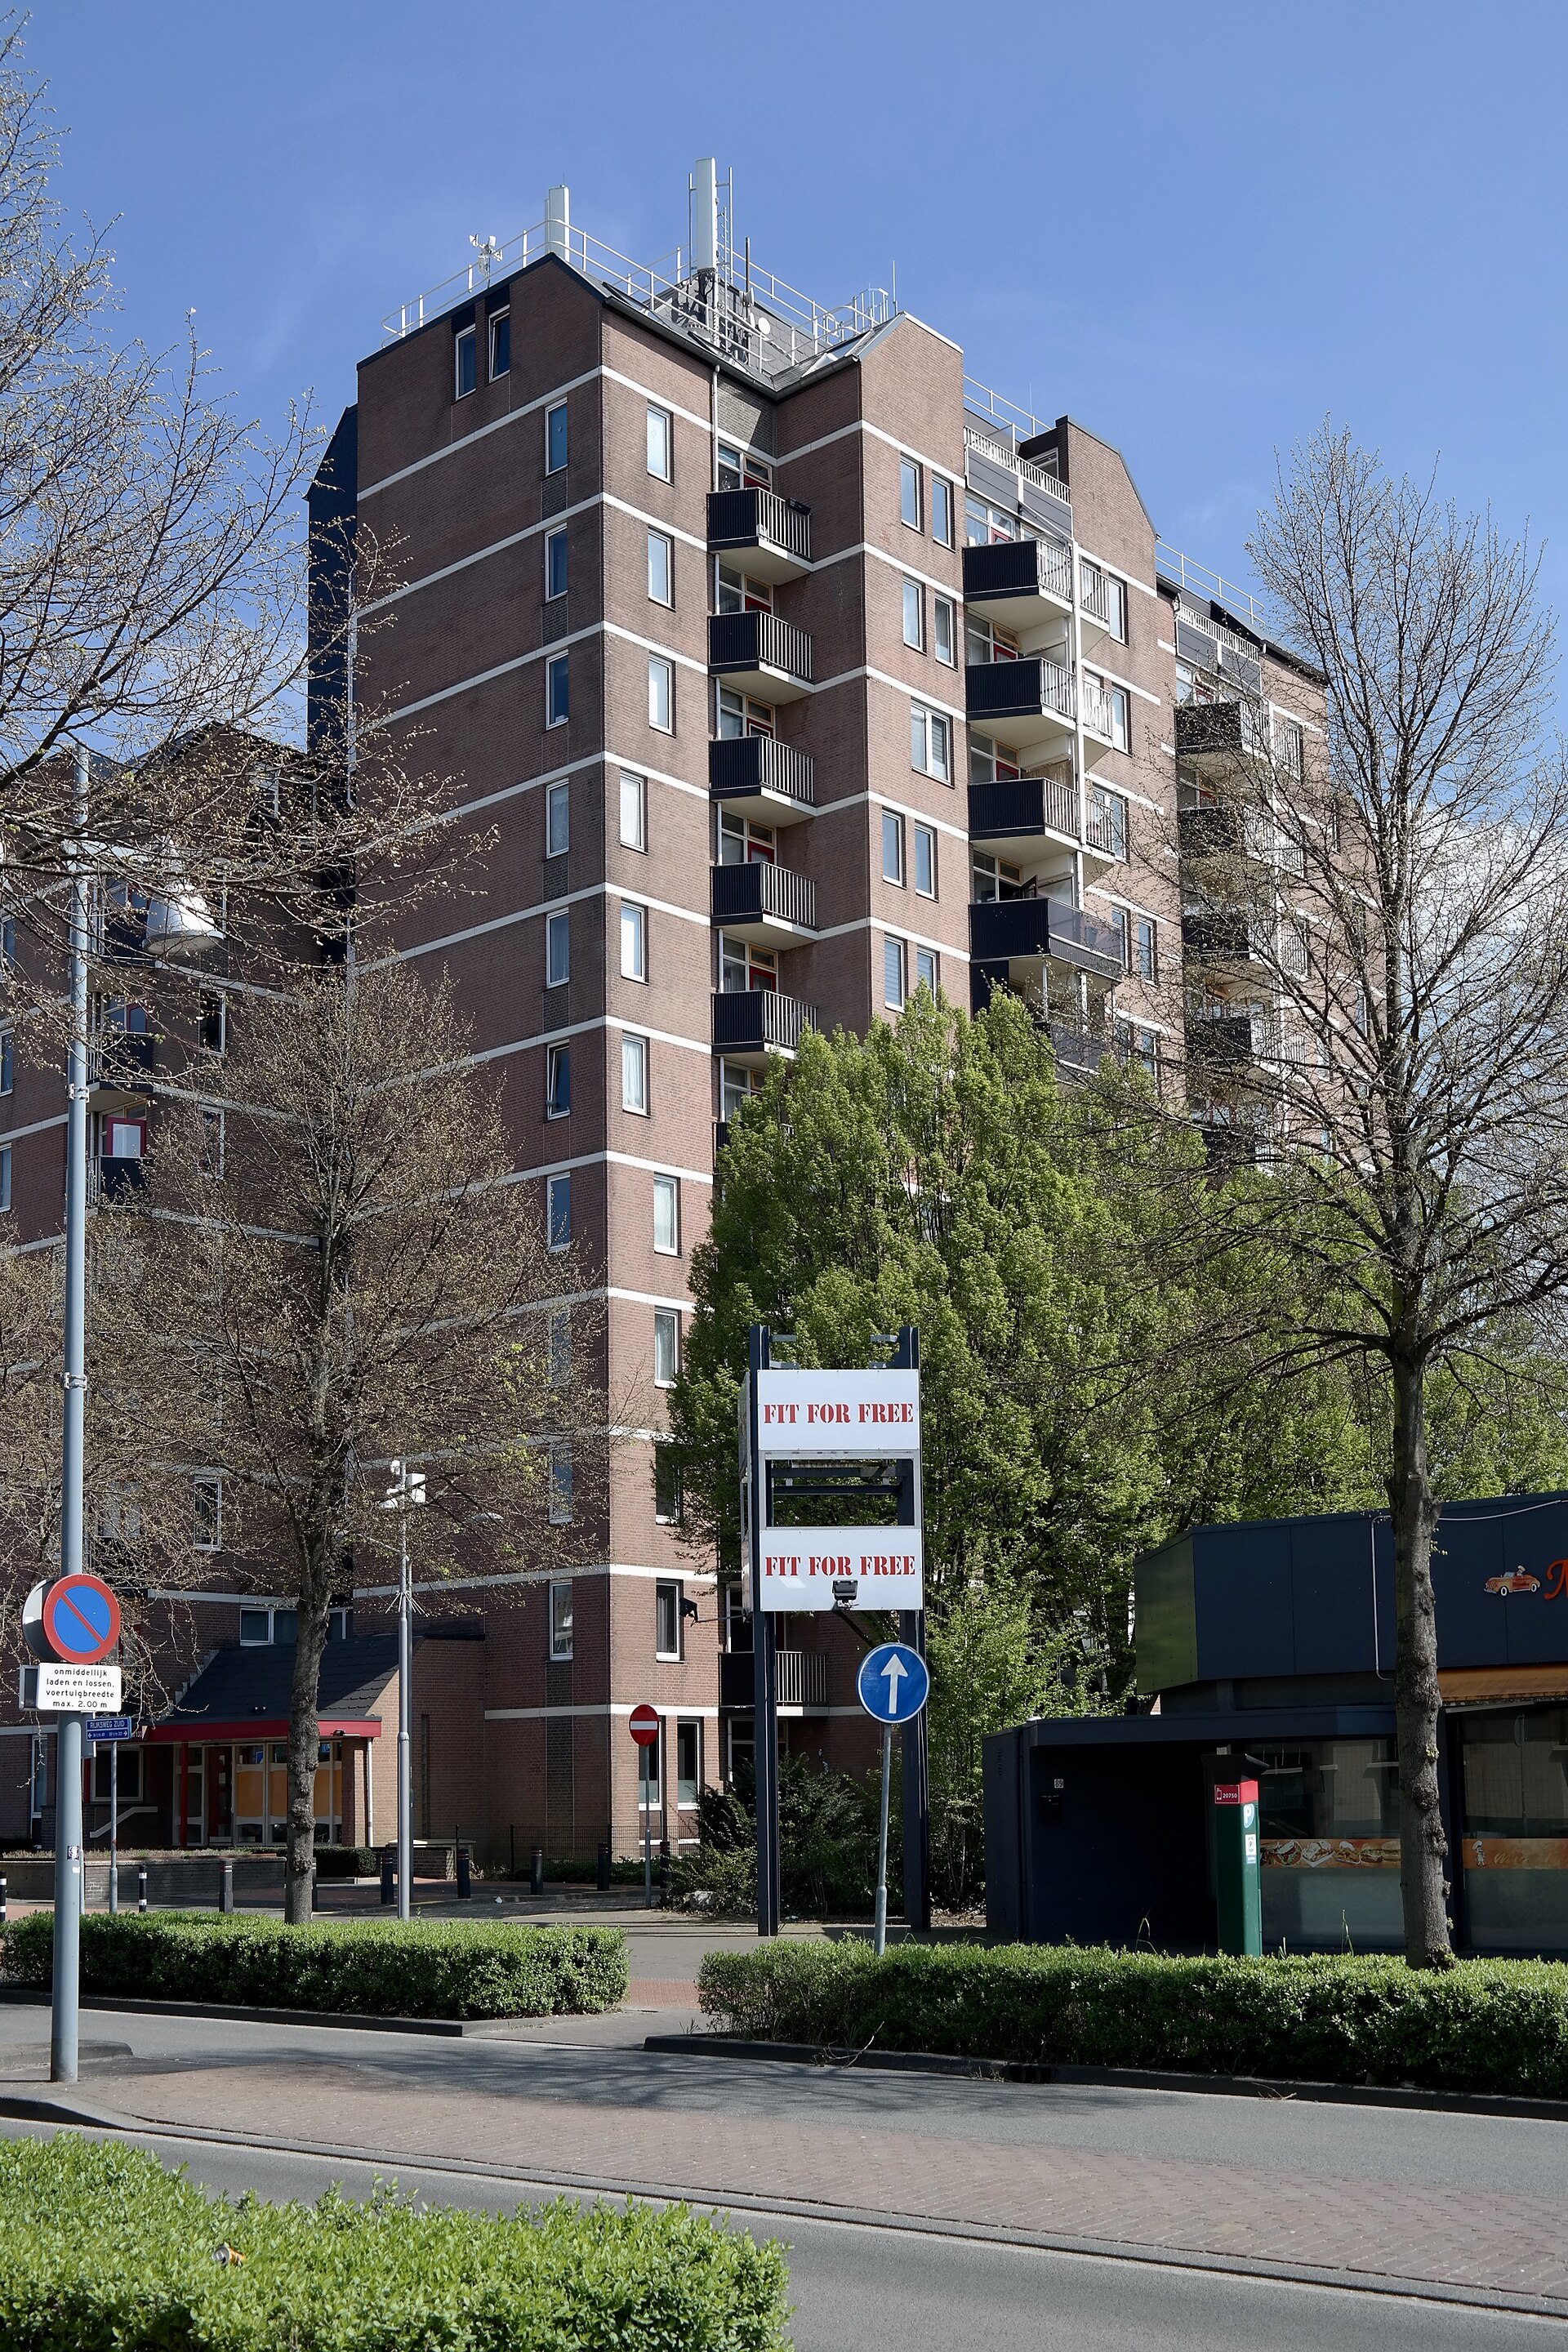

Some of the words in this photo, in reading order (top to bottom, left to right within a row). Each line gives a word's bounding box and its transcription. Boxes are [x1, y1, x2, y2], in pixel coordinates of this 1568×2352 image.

[764, 1404, 800, 1423] FIT
[807, 1404, 851, 1423] FOR
[858, 1403, 914, 1423] FREE
[765, 1557, 801, 1576] FIT
[808, 1556, 853, 1576] FOR
[860, 1556, 915, 1575] FREE
[54, 1668, 108, 1677] onmiddellijk
[46, 1690, 114, 1698] voertuigbreedte
[1055, 1780, 1063, 1788] 89
